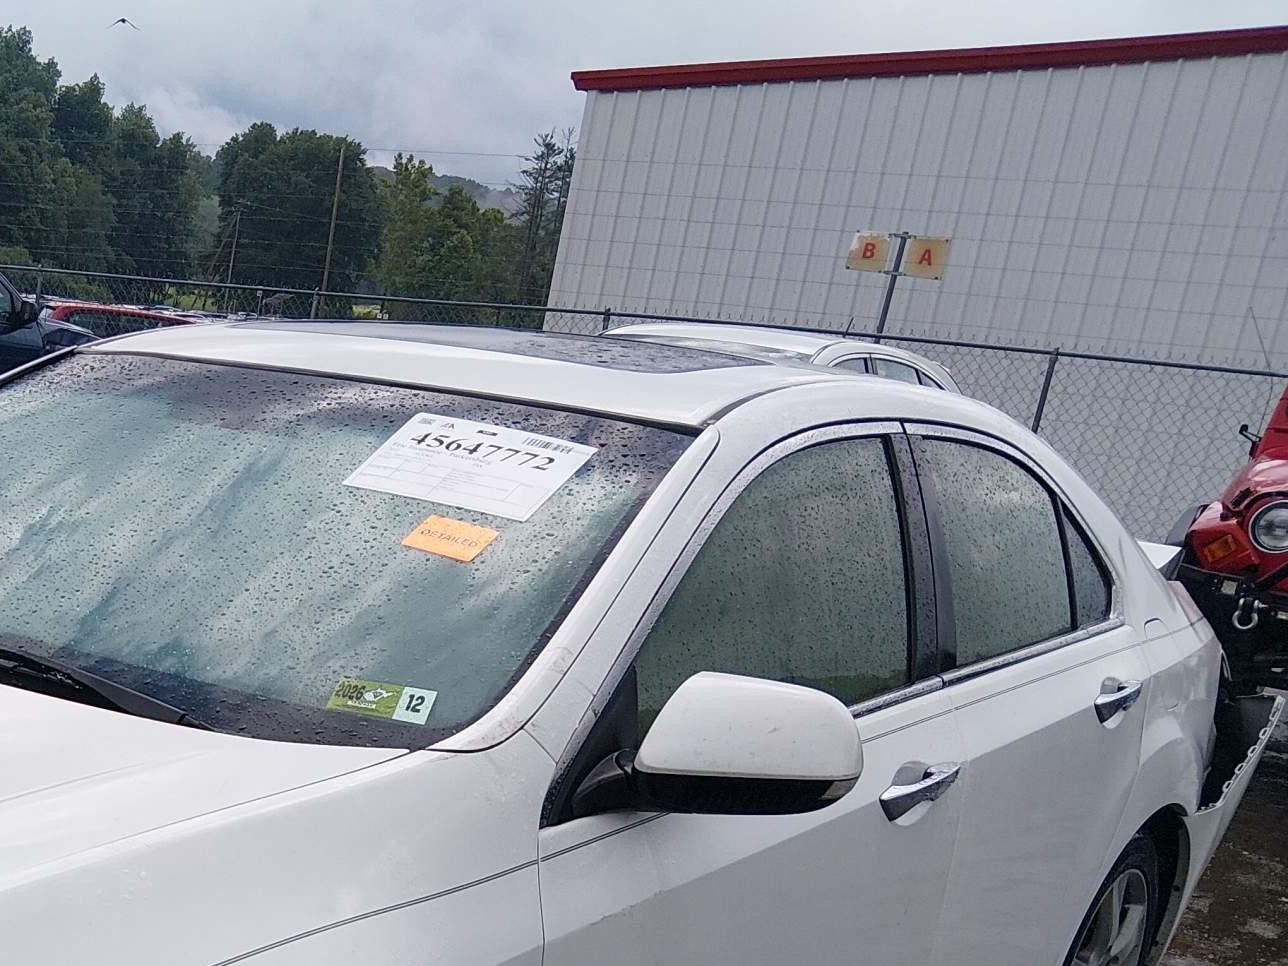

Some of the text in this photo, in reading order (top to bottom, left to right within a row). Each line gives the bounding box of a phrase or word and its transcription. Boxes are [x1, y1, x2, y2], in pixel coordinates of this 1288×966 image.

[861, 242, 876, 259] B
[917, 248, 932, 266] A
[410, 431, 555, 471] 45647772
[335, 681, 366, 700] 2026
[405, 693, 425, 713] 12
